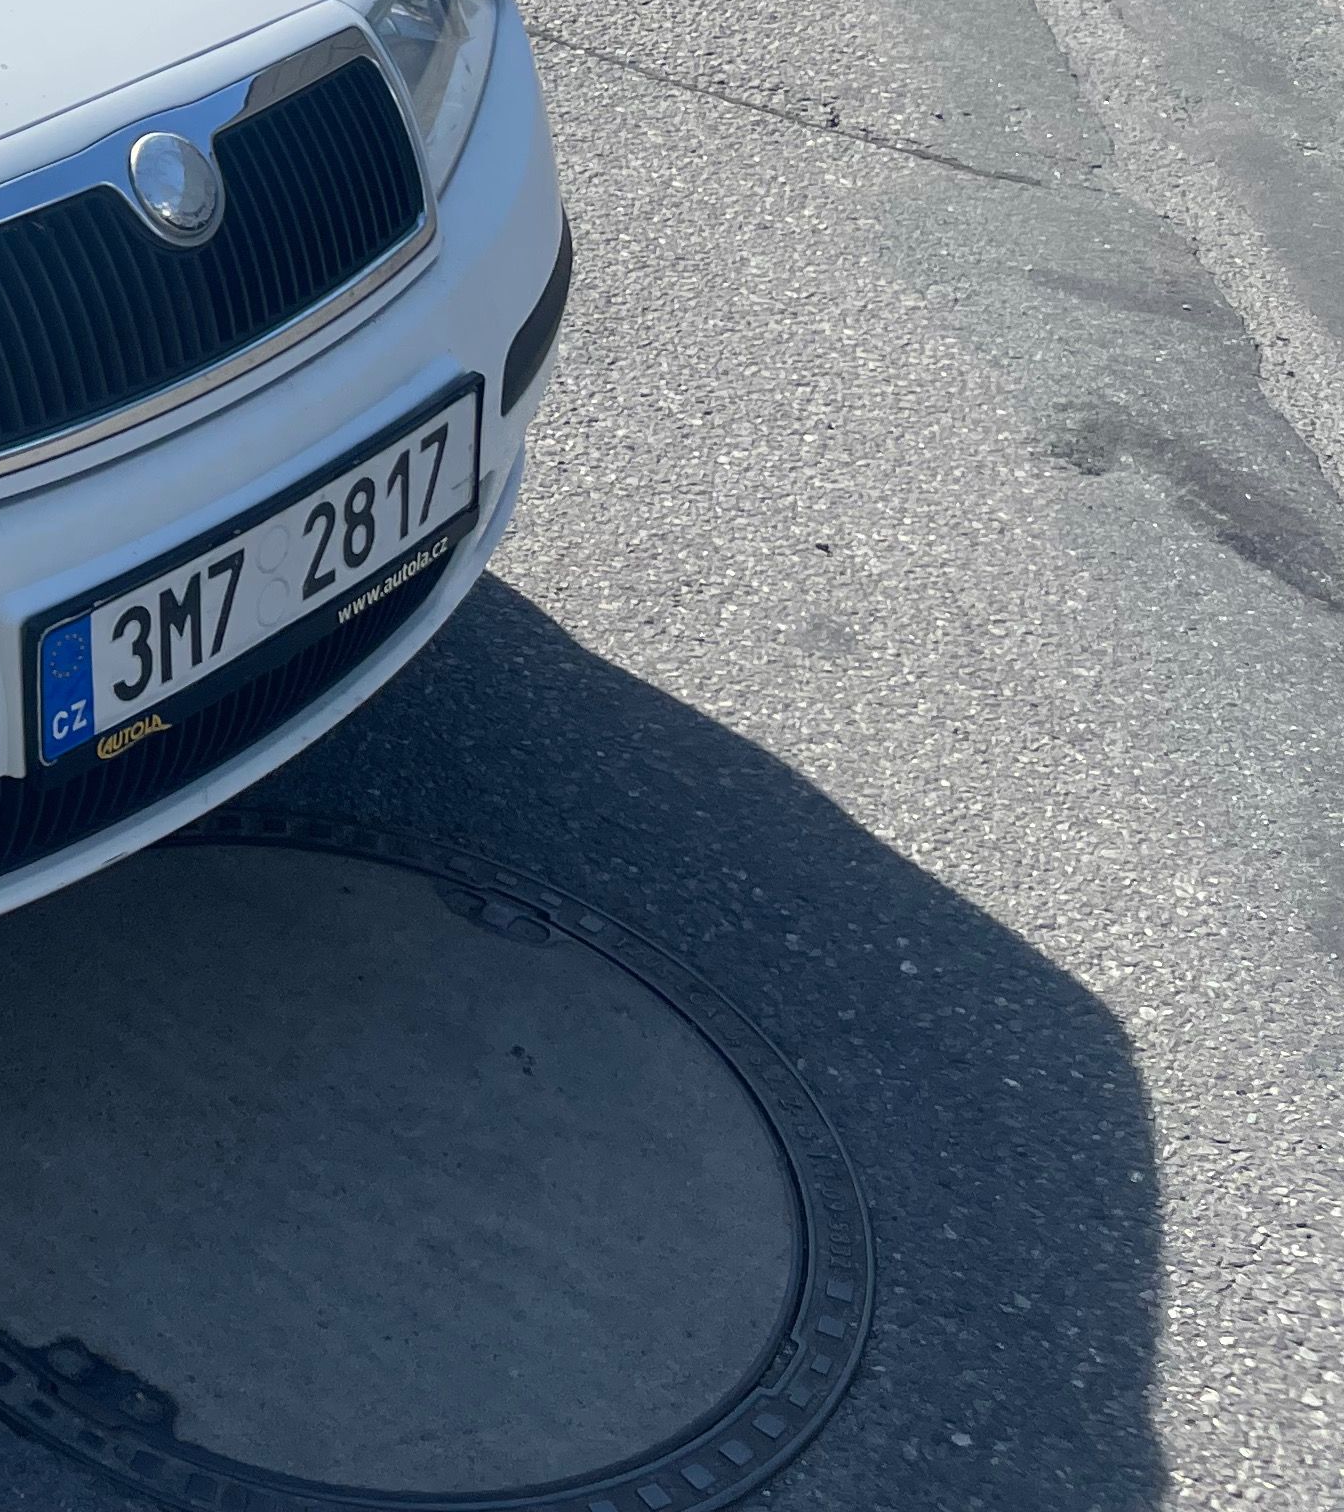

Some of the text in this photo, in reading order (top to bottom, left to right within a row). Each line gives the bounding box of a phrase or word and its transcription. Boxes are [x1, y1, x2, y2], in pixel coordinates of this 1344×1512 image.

[112, 422, 449, 702] 3M7 2817
[338, 536, 449, 624] www.autola.cz
[52, 699, 89, 740] CZ
